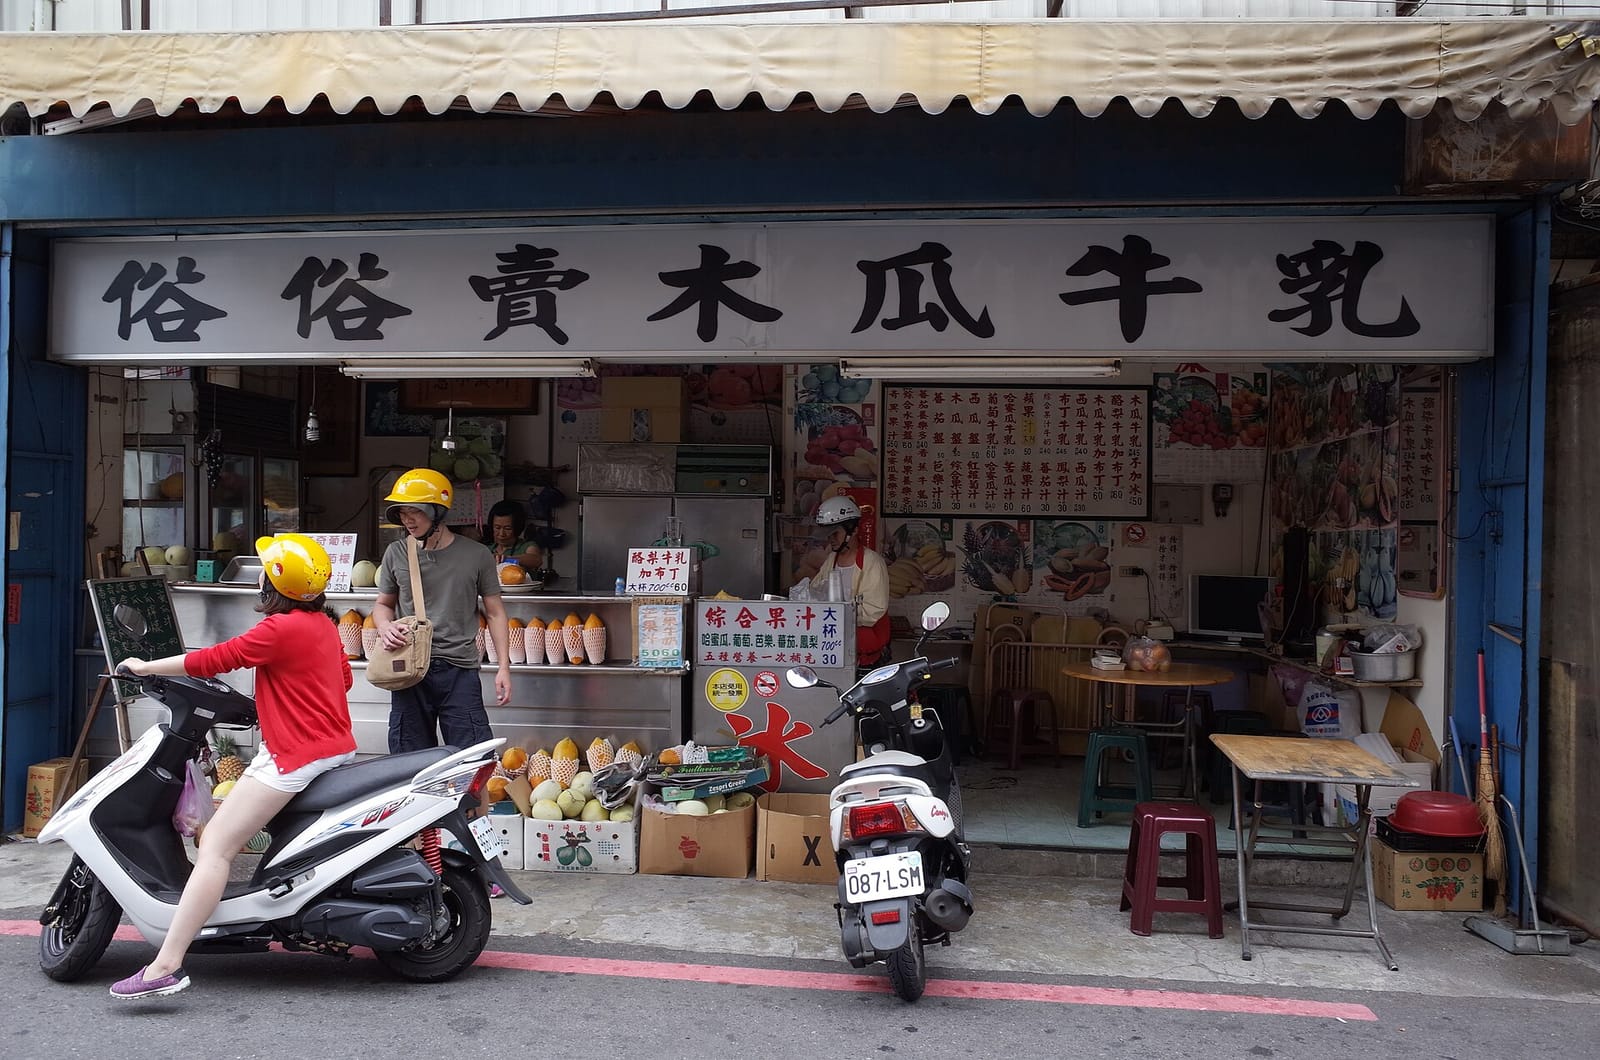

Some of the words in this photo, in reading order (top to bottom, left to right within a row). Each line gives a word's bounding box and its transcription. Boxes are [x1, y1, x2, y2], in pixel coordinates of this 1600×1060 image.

[102, 234, 1421, 344] 俗俗賣木瓜牛乳
[1058, 393, 1071, 445] 布丁牛乳
[1075, 394, 1088, 445] 西瓜牛乳
[1129, 395, 1142, 447] 木瓜牛乳
[1094, 395, 1106, 486] 木瓜牛乳加布丁
[1075, 463, 1087, 501] 西瓜汁
[1129, 458, 1142, 495] 不加冰
[632, 550, 687, 565] 酪梨牛乳
[629, 583, 646, 591] 大杯
[674, 583, 687, 591] 60
[639, 567, 680, 580] 加布丁
[705, 606, 816, 630] 綜合果汁
[823, 608, 837, 638] 大杯
[704, 652, 816, 664] 五種營養一次補充
[822, 654, 836, 665] 30
[708, 783, 728, 792] Zespri
[728, 779, 746, 788] Green
[803, 836, 821, 866] X
